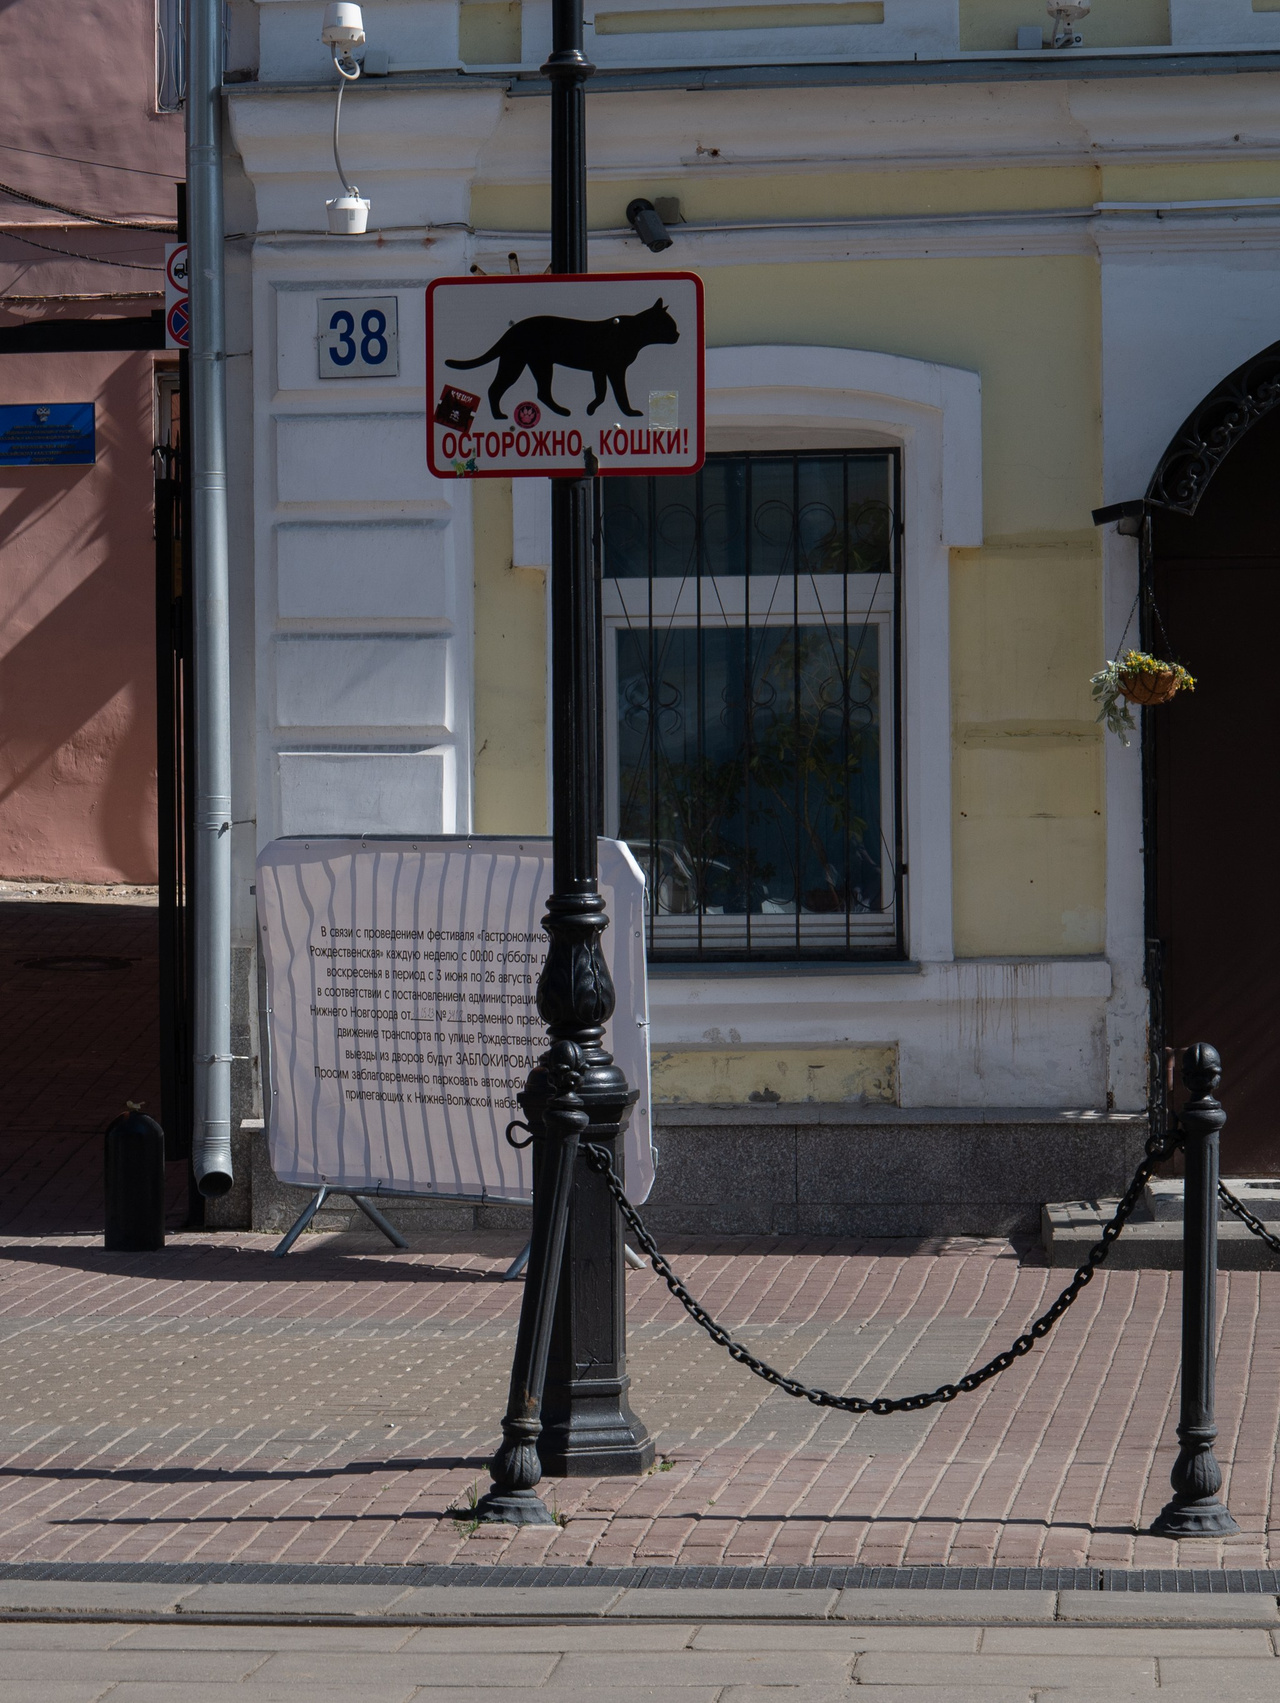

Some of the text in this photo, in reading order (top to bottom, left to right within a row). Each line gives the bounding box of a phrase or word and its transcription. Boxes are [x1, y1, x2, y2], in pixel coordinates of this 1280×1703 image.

[329, 309, 388, 366] 38
[442, 428, 689, 458] ОСТОРОЖНО КОШКИ!
[321, 925, 552, 944] В связи с проведением фестиваля «Гастрономичес
[310, 945, 384, 959] Рождественская»
[386, 950, 421, 962] каждую
[424, 950, 459, 963] неделю
[462, 952, 468, 962] с
[470, 949, 494, 962] 00:00
[497, 950, 538, 965] субботы
[326, 967, 383, 981] воскресенья
[385, 970, 390, 979] в
[392, 970, 426, 982] период
[428, 971, 434, 981] с
[436, 969, 442, 981] 3
[444, 971, 468, 983] июня
[470, 972, 482, 982] по
[484, 970, 496, 983] 26
[498, 973, 532, 986] августа
[317, 987, 322, 997] в
[324, 987, 382, 999] соответствии
[384, 990, 390, 999] с
[392, 990, 466, 1003] постановлением
[310, 1004, 348, 1018] Нижнего
[350, 1006, 398, 1021] Новгорода
[400, 1011, 411, 1020] от
[436, 1009, 446, 1021] №
[467, 1013, 514, 1025] временно
[516, 1015, 547, 1028] прекр
[337, 1028, 553, 1047] движение транспорта по улице Рождественско
[345, 1050, 539, 1068] выезды из дворов будут ЗАБЛОКИРОВАН
[314, 1066, 527, 1089] Просим заблаговременно парковать автомоби
[345, 1089, 523, 1111] прилегающих к Нижне-Волжской набер
